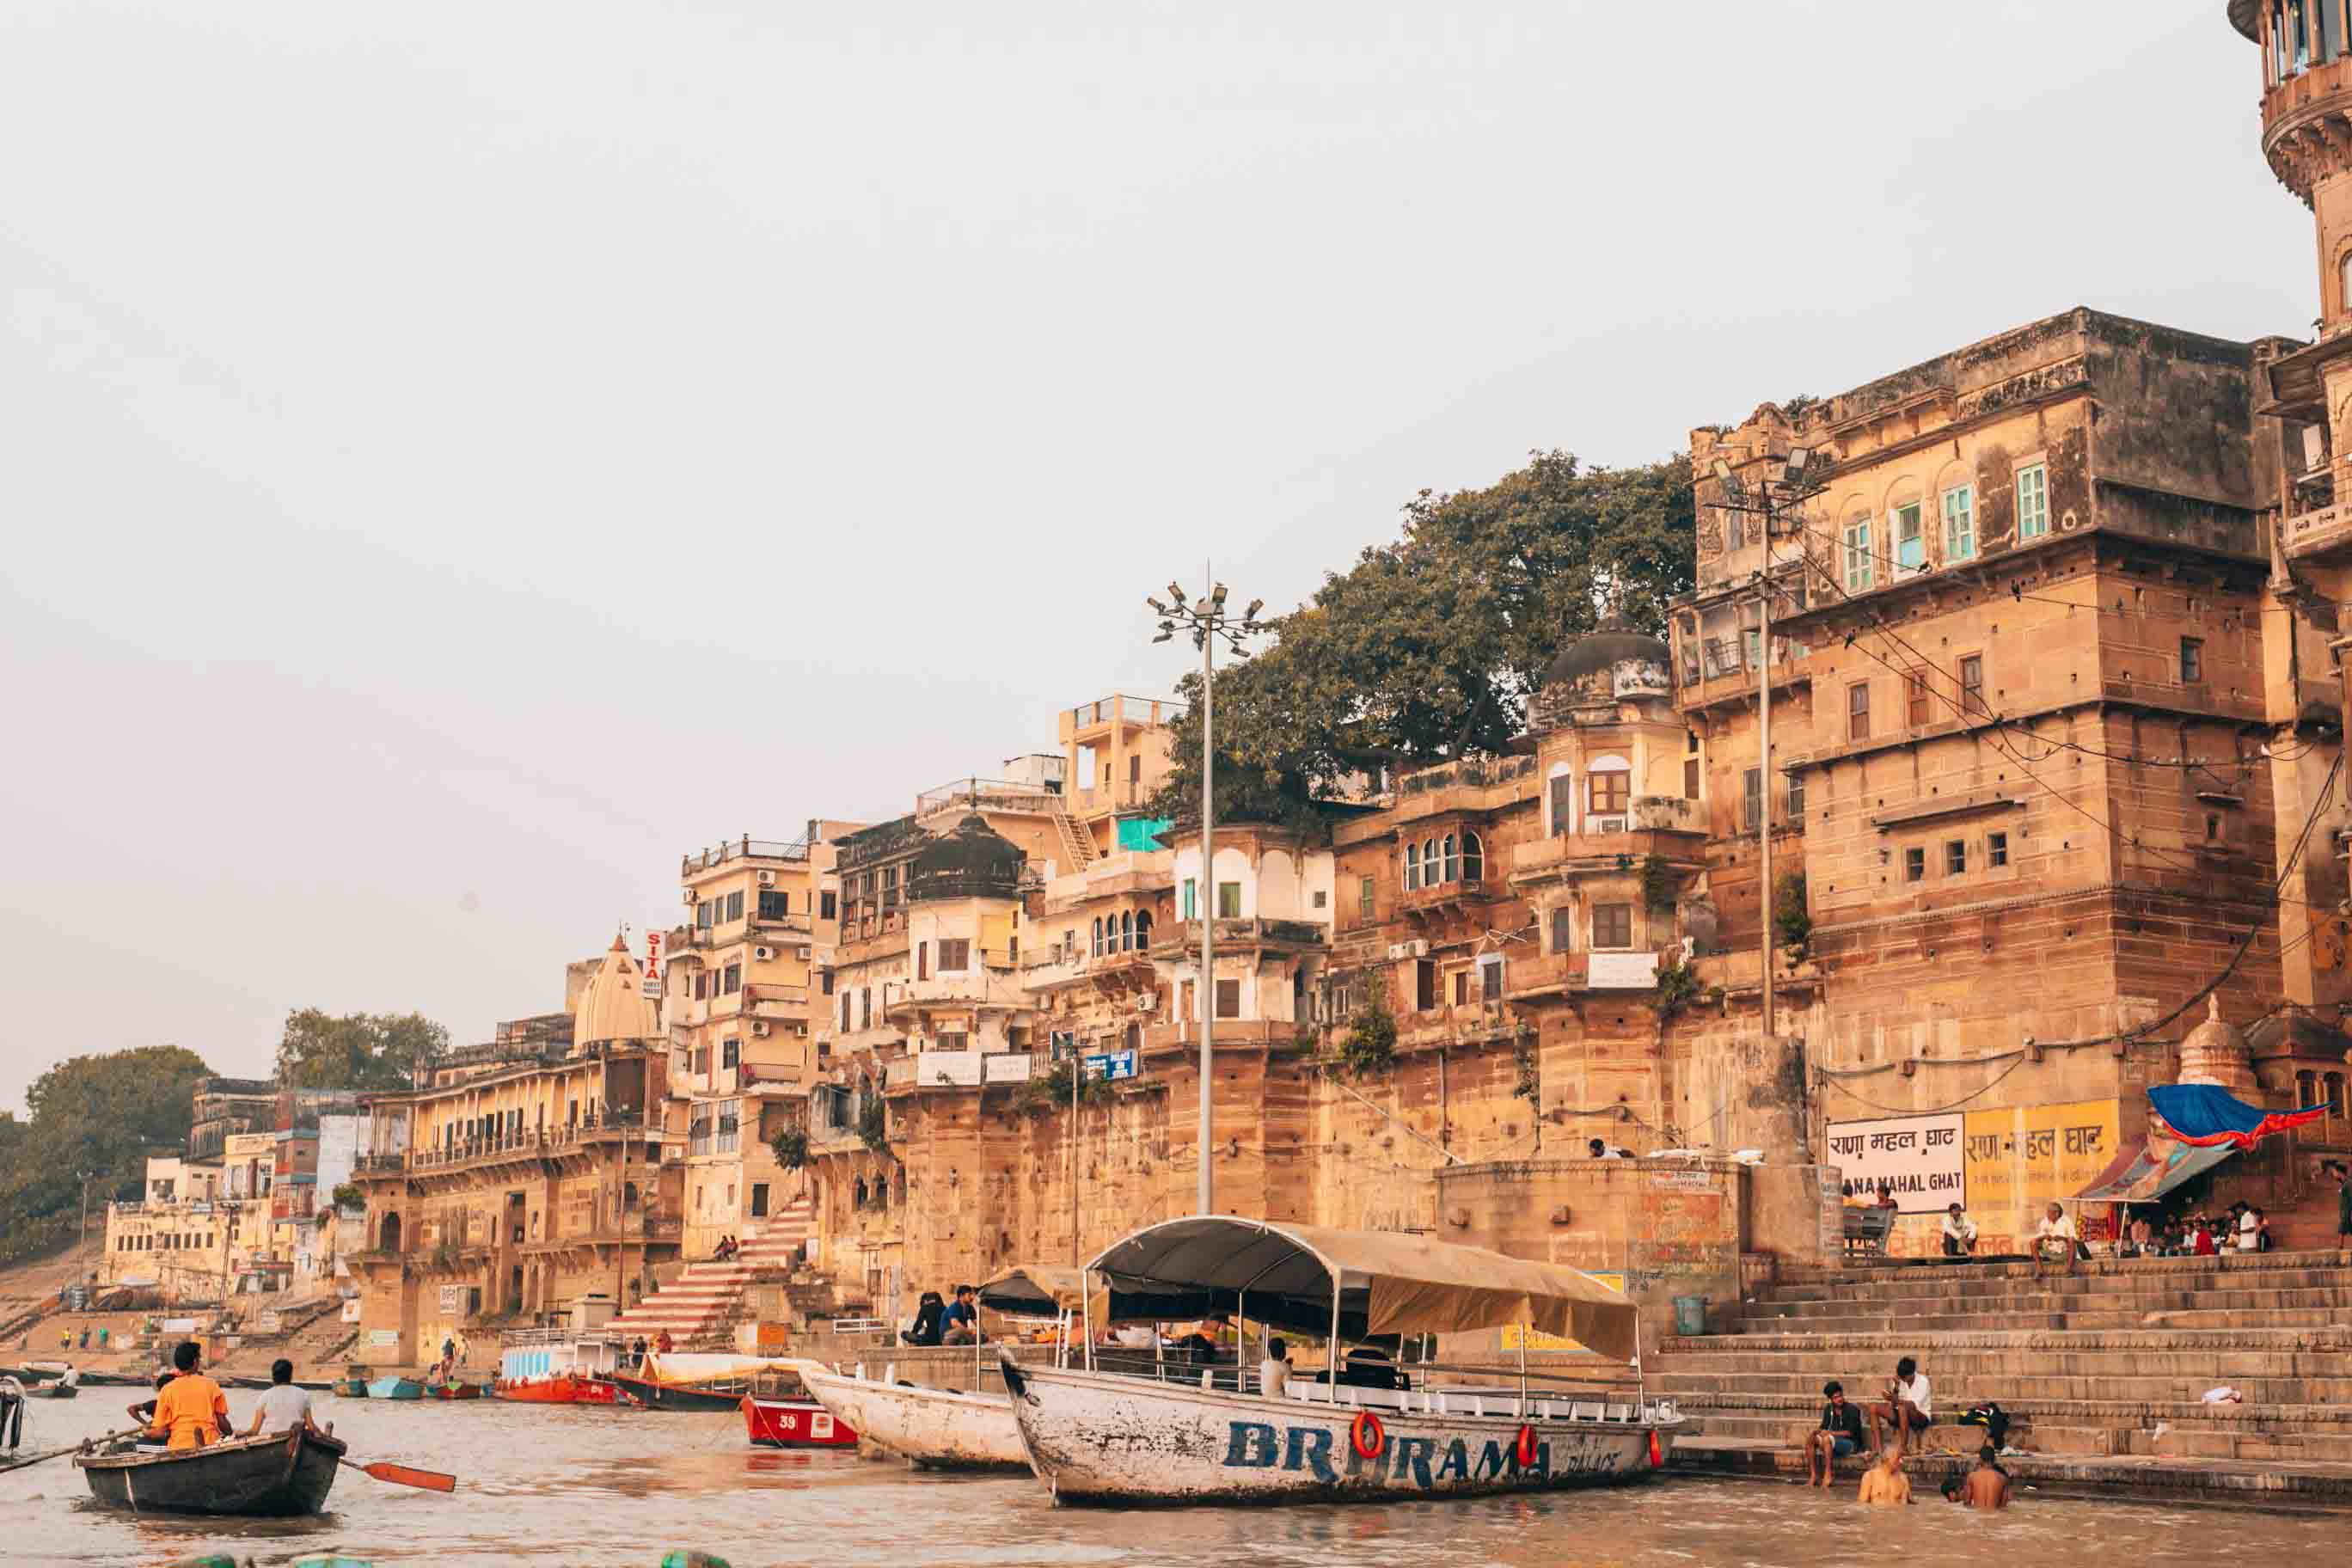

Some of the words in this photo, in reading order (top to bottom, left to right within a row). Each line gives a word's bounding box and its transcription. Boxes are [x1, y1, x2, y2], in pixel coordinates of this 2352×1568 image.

[646, 934, 660, 979] SITA
[1829, 1135, 1865, 1155] राणा
[1871, 1131, 1917, 1152] महल
[1926, 1128, 1956, 1146] घाट
[2065, 1125, 2103, 1155] घाट
[1929, 1172, 1961, 1191] GHAT
[779, 1415, 796, 1430] 39
